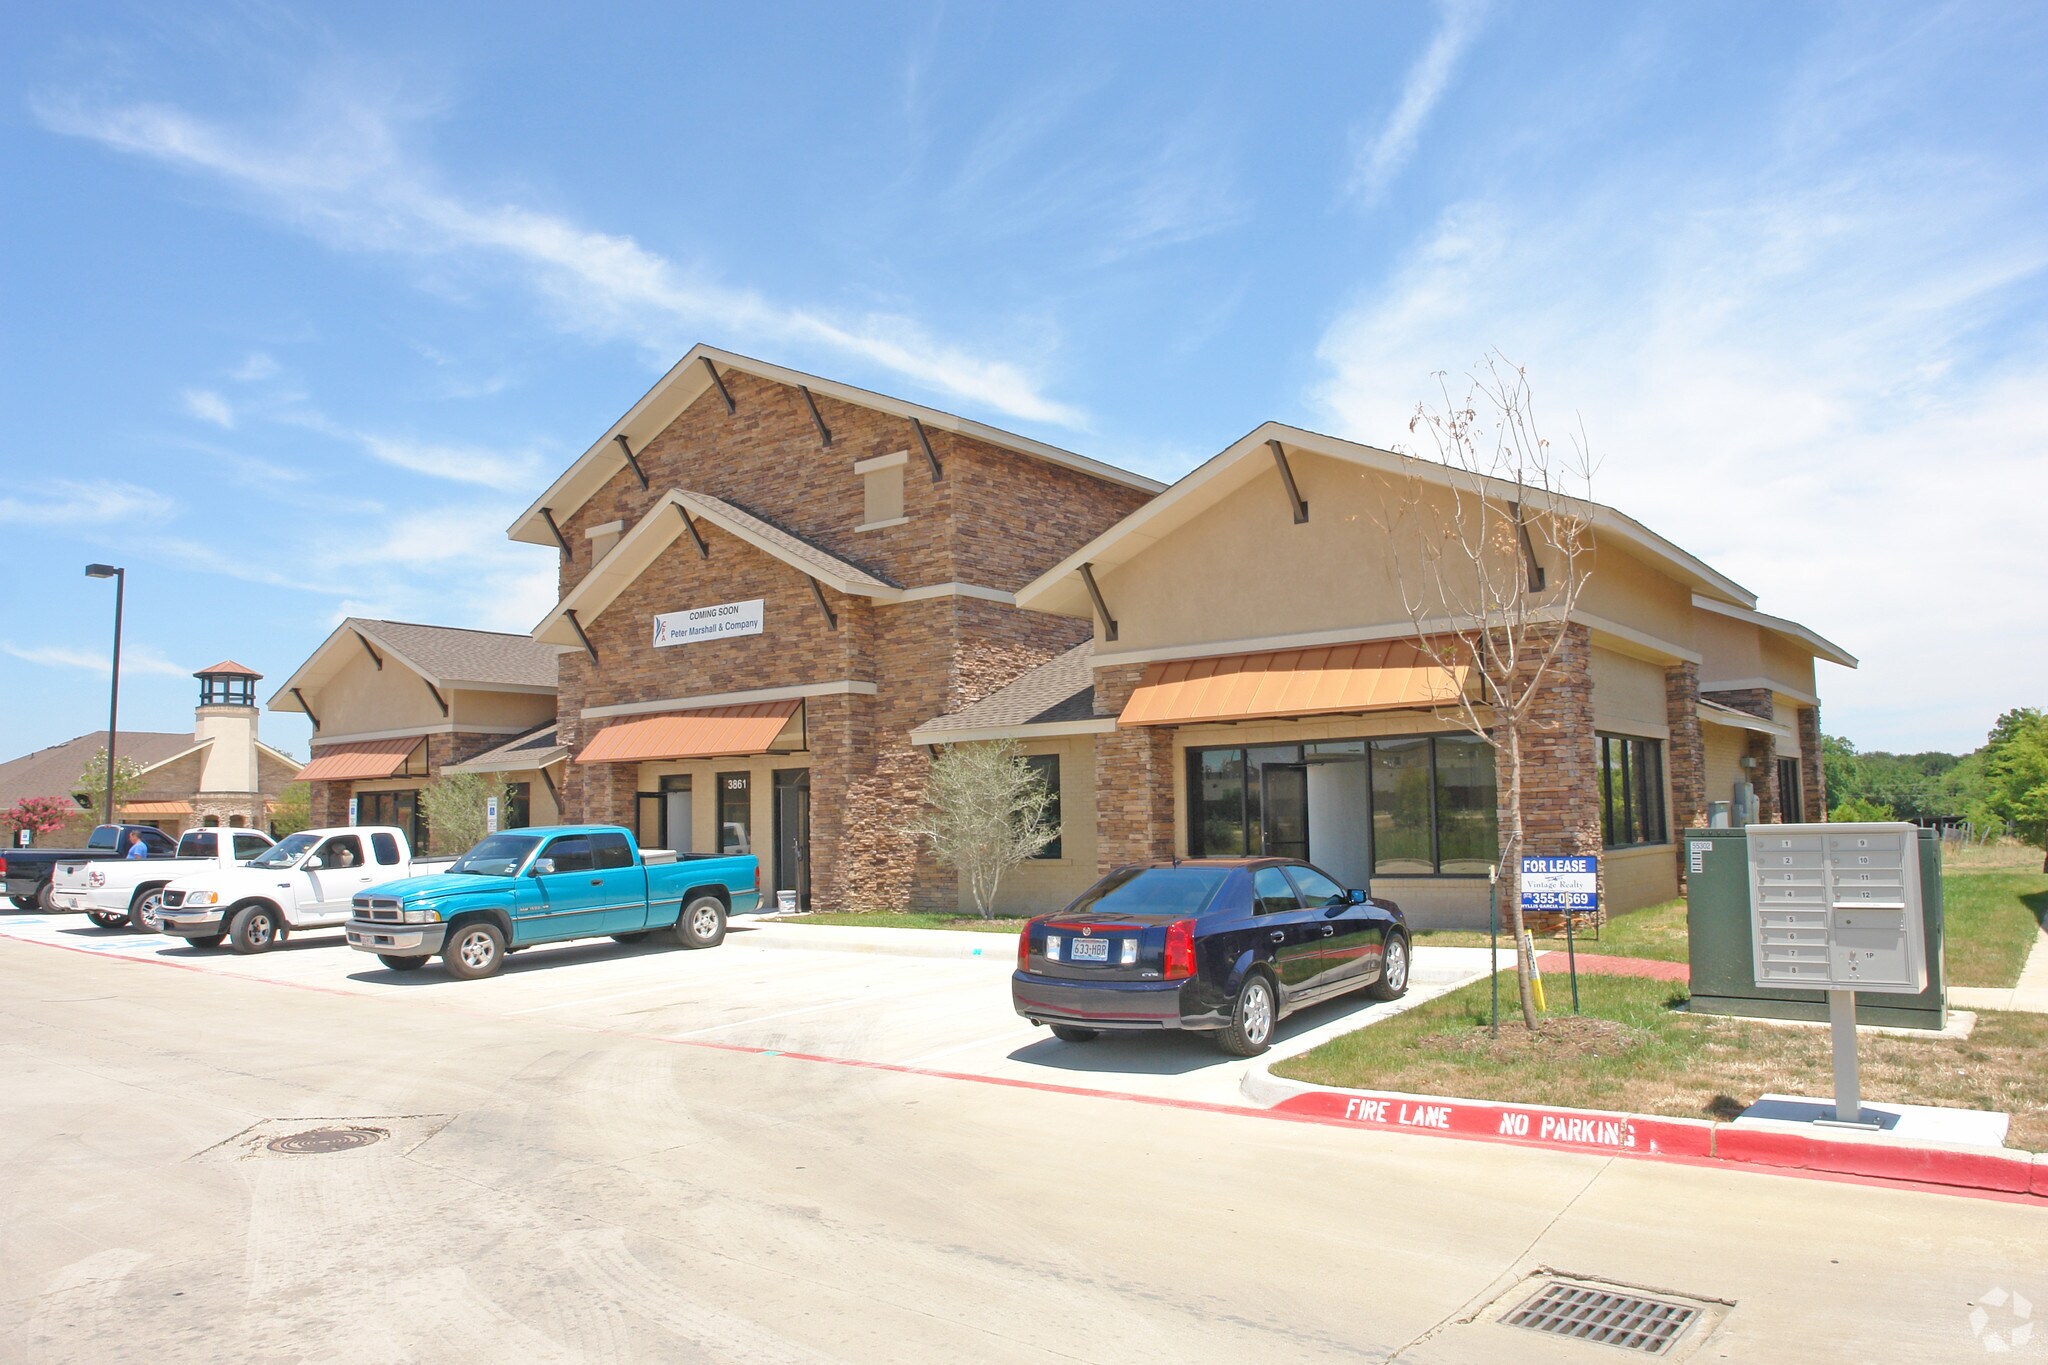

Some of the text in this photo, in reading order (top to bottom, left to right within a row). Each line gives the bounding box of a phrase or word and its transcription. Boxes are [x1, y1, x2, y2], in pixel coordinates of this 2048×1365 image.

[690, 605, 739, 621] COMING SOON
[670, 619, 759, 638] Peter Marshall & Company
[728, 779, 747, 790] 3861
[1523, 860, 1587, 873] FOR LEASE
[1527, 879, 1584, 889] Vintage Realty
[1345, 1097, 1452, 1129] FIRE LANE
[1500, 1112, 1635, 1148] NO PARKING
